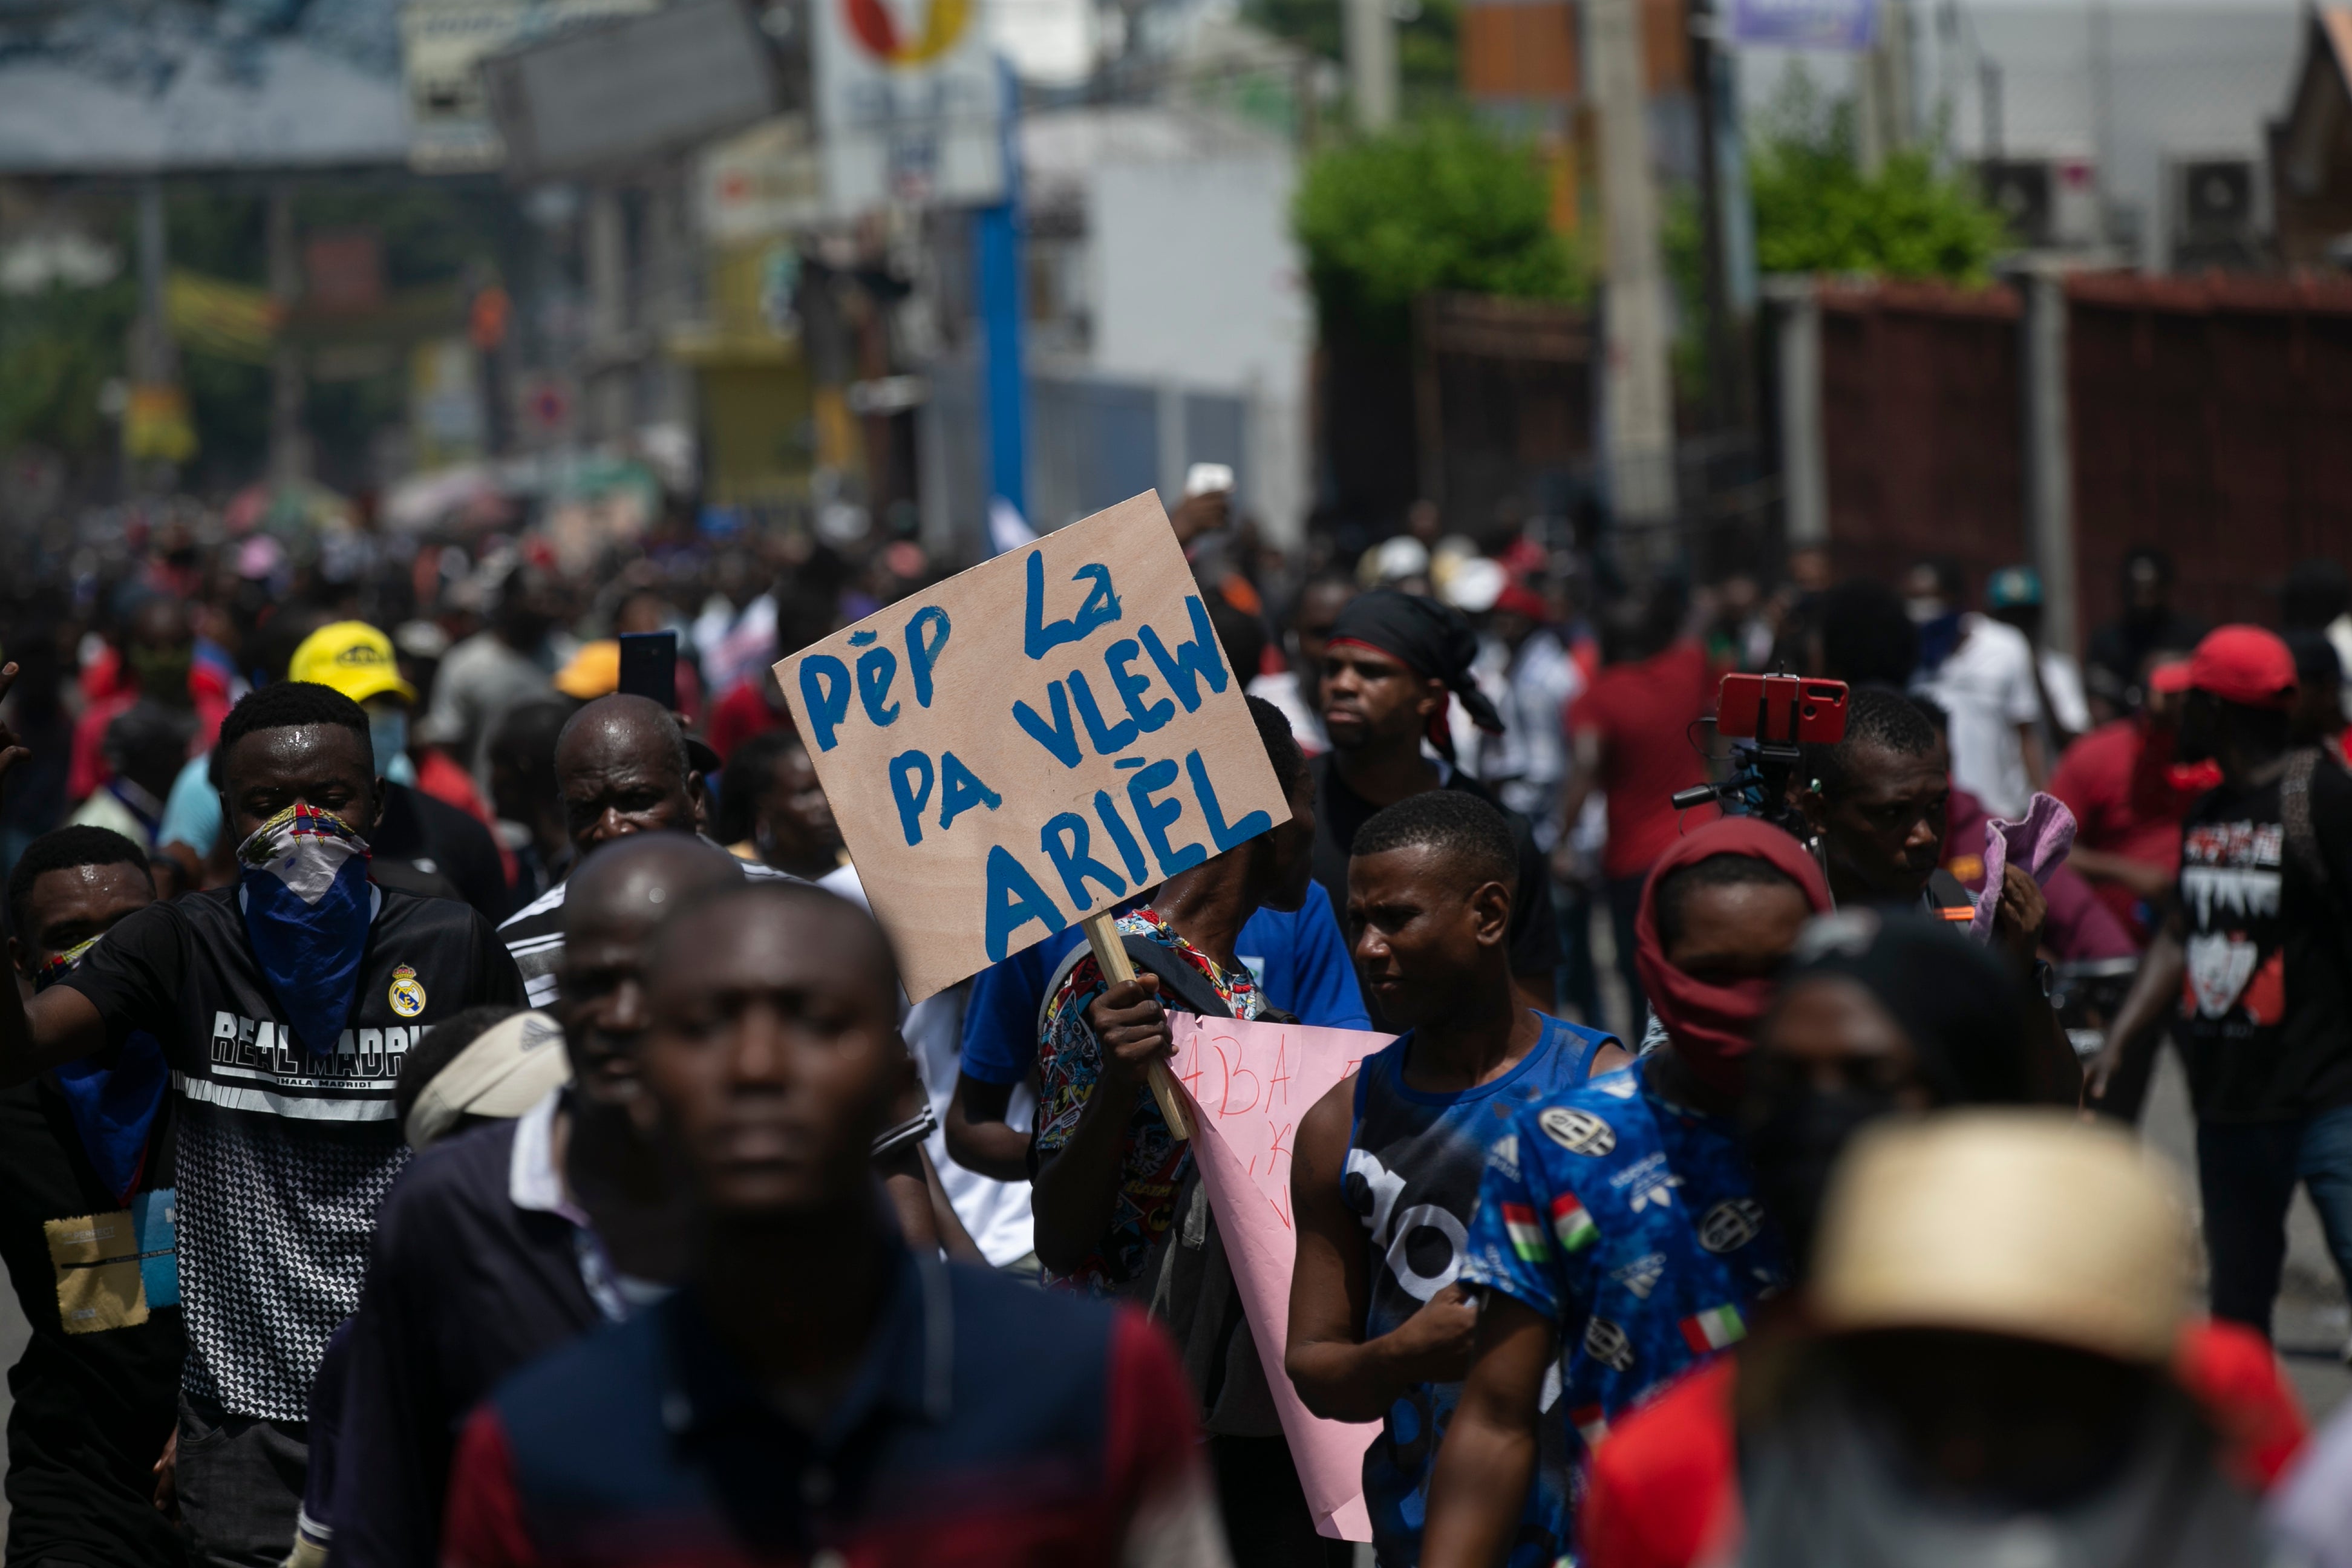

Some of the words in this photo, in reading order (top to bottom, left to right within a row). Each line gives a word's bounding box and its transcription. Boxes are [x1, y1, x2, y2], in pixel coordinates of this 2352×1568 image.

[889, 750, 1002, 846] PA
[1012, 595, 1228, 769] VLEW
[211, 1011, 298, 1073] REAL
[306, 1025, 436, 1077] MADR
[1126, 1180, 1181, 1198] BATM
